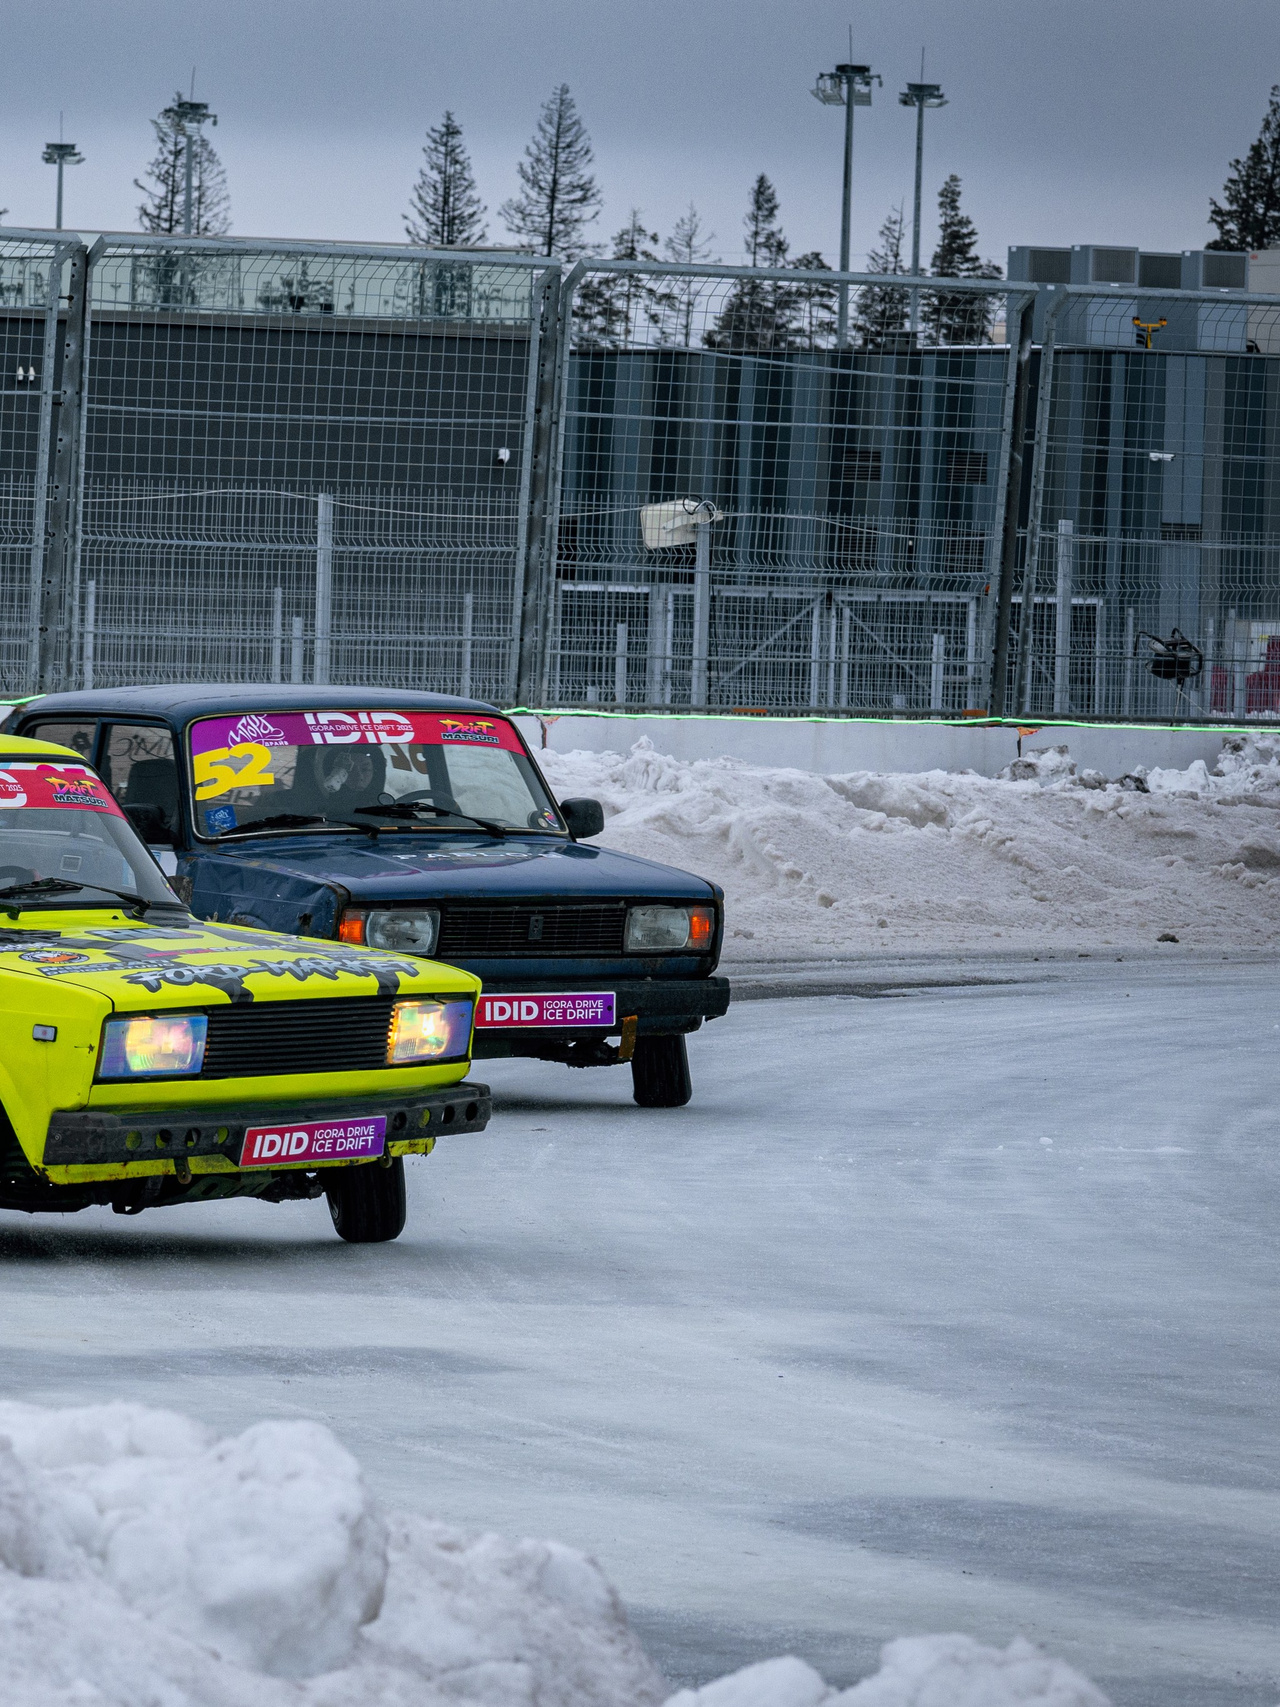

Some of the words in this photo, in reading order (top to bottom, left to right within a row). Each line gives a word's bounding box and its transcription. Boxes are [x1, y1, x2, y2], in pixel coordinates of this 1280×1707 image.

[193, 742, 275, 800] 52
[5, 784, 24, 792] 2025
[485, 1001, 539, 1021] IDID
[543, 1000, 573, 1009] IGORA
[575, 1000, 603, 1008] DRIVE
[543, 1010, 563, 1020] ICE
[566, 1009, 603, 1020] DRIFT
[314, 1129, 345, 1140] IGORA
[347, 1125, 375, 1137] DRIVE
[252, 1131, 309, 1158] IDID
[311, 1140, 332, 1153] ICE
[336, 1136, 375, 1151] DRIFT
